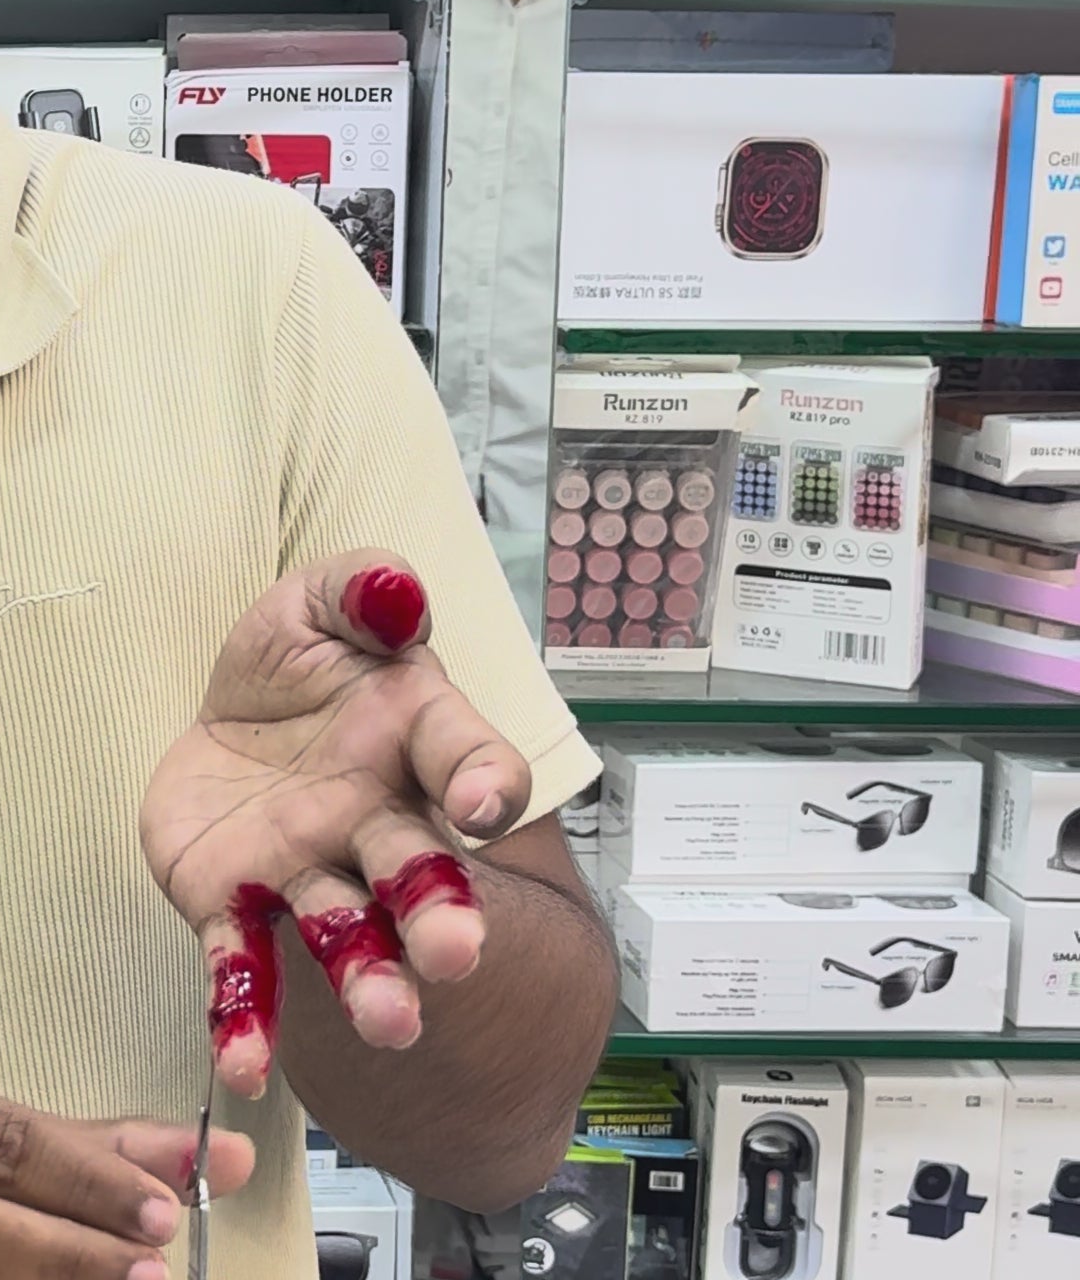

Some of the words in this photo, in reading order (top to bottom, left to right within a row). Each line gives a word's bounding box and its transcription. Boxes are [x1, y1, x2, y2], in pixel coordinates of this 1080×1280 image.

[178, 87, 226, 105] FLY
[247, 87, 311, 103] PHONE
[317, 87, 392, 103] HOLDER
[615, 287, 655, 299] ULTRA
[658, 287, 673, 299] S8
[604, 394, 688, 411] Runzon
[781, 389, 864, 412] Runzon
[625, 414, 637, 423] RZ
[641, 414, 663, 423] 819
[790, 412, 803, 421] RZ
[805, 412, 827, 423] 819
[829, 415, 851, 426] pro
[743, 534, 755, 543] 10
[775, 570, 807, 581] Product
[808, 573, 849, 584] parameter
[741, 1094, 782, 1106] Keychain
[607, 1113, 672, 1124] RECHARGEABLE
[587, 1124, 639, 1136] KEYCHAIN
[642, 1124, 672, 1136] LIGHT
